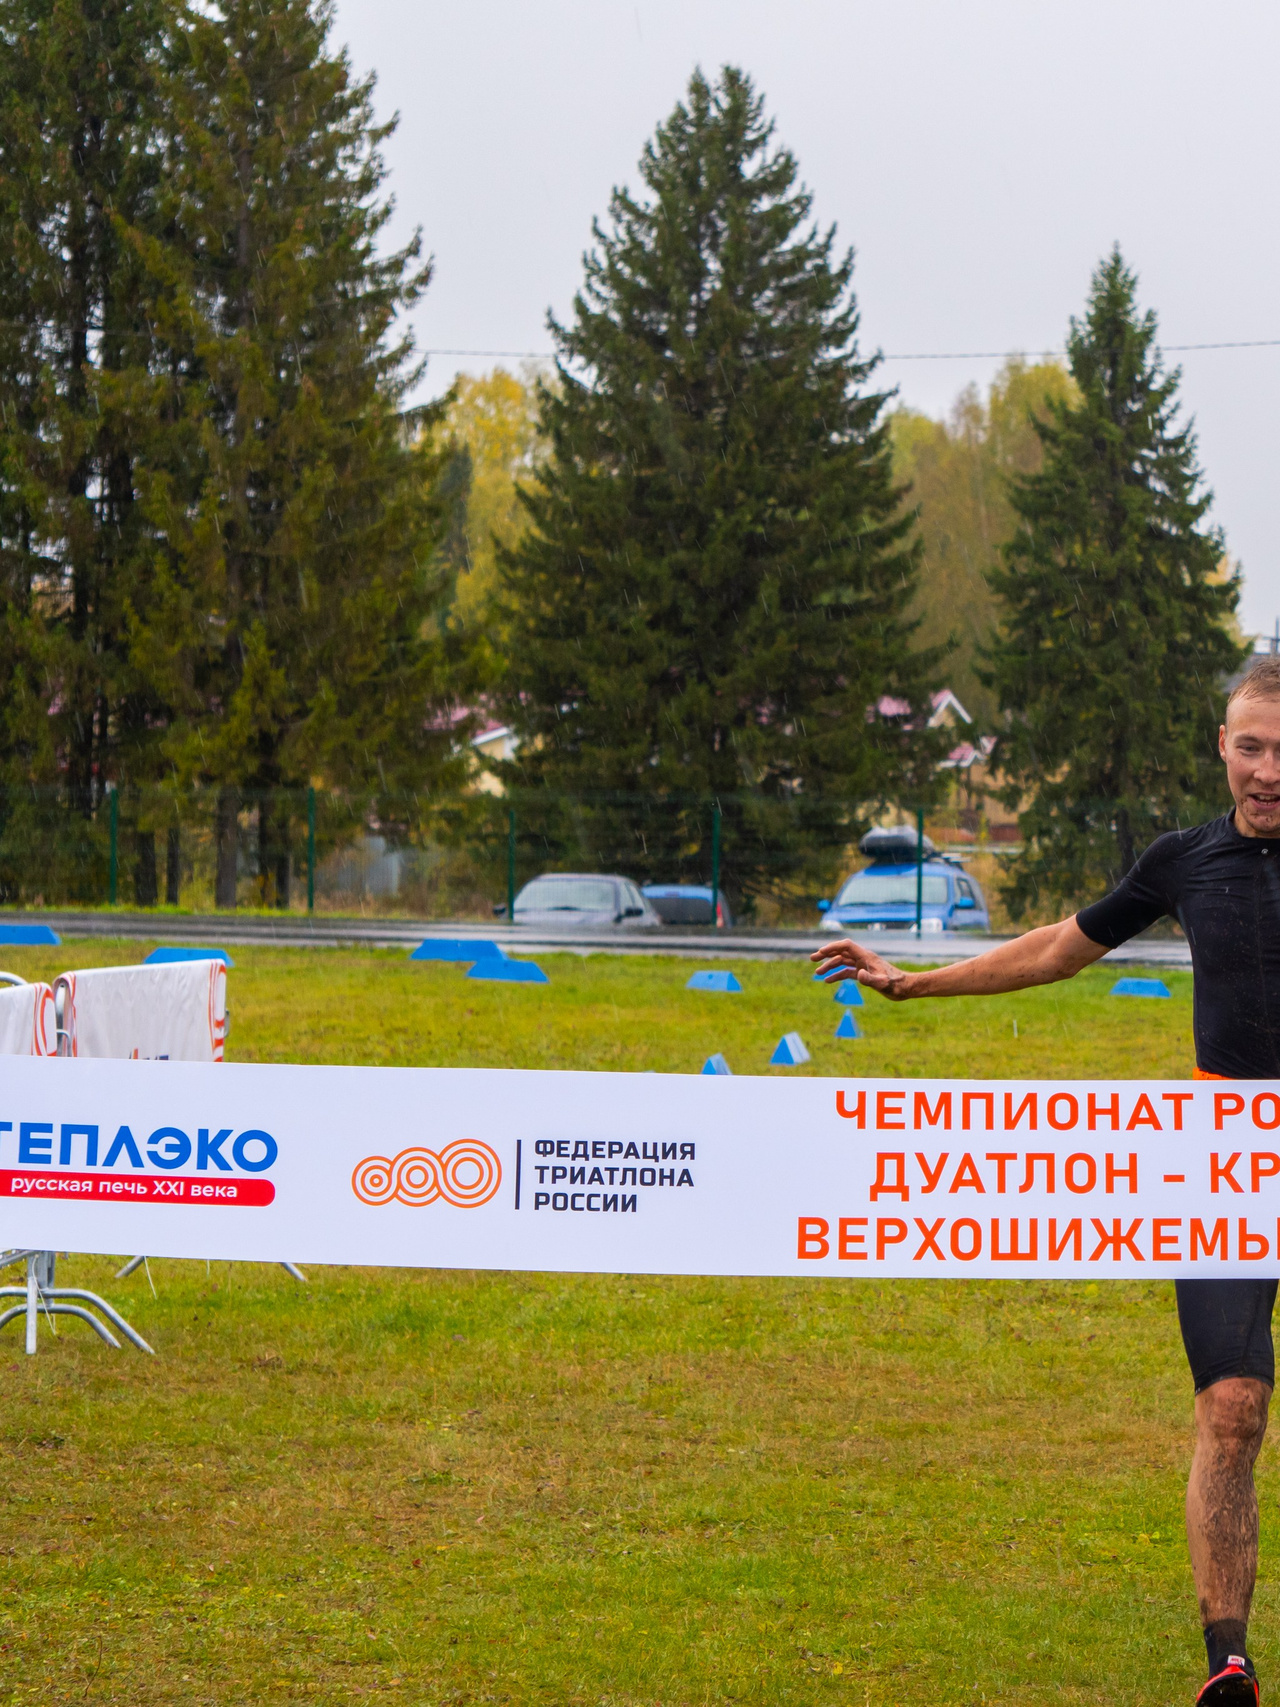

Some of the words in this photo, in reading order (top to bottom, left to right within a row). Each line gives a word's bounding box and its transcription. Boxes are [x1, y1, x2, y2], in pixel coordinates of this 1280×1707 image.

[835, 1090, 1194, 1131] ЧЕМПИОНАТ
[534, 1139, 696, 1163] ФЕДЕРАЦИЯ
[11, 1177, 94, 1193] русская
[99, 1181, 148, 1195] печь
[152, 1180, 185, 1196] XXI
[190, 1184, 238, 1198] века
[534, 1165, 695, 1187] ТРИАТЛОНА
[869, 1152, 1138, 1203] ДУАТЛОН
[534, 1192, 638, 1213] РОССИИ
